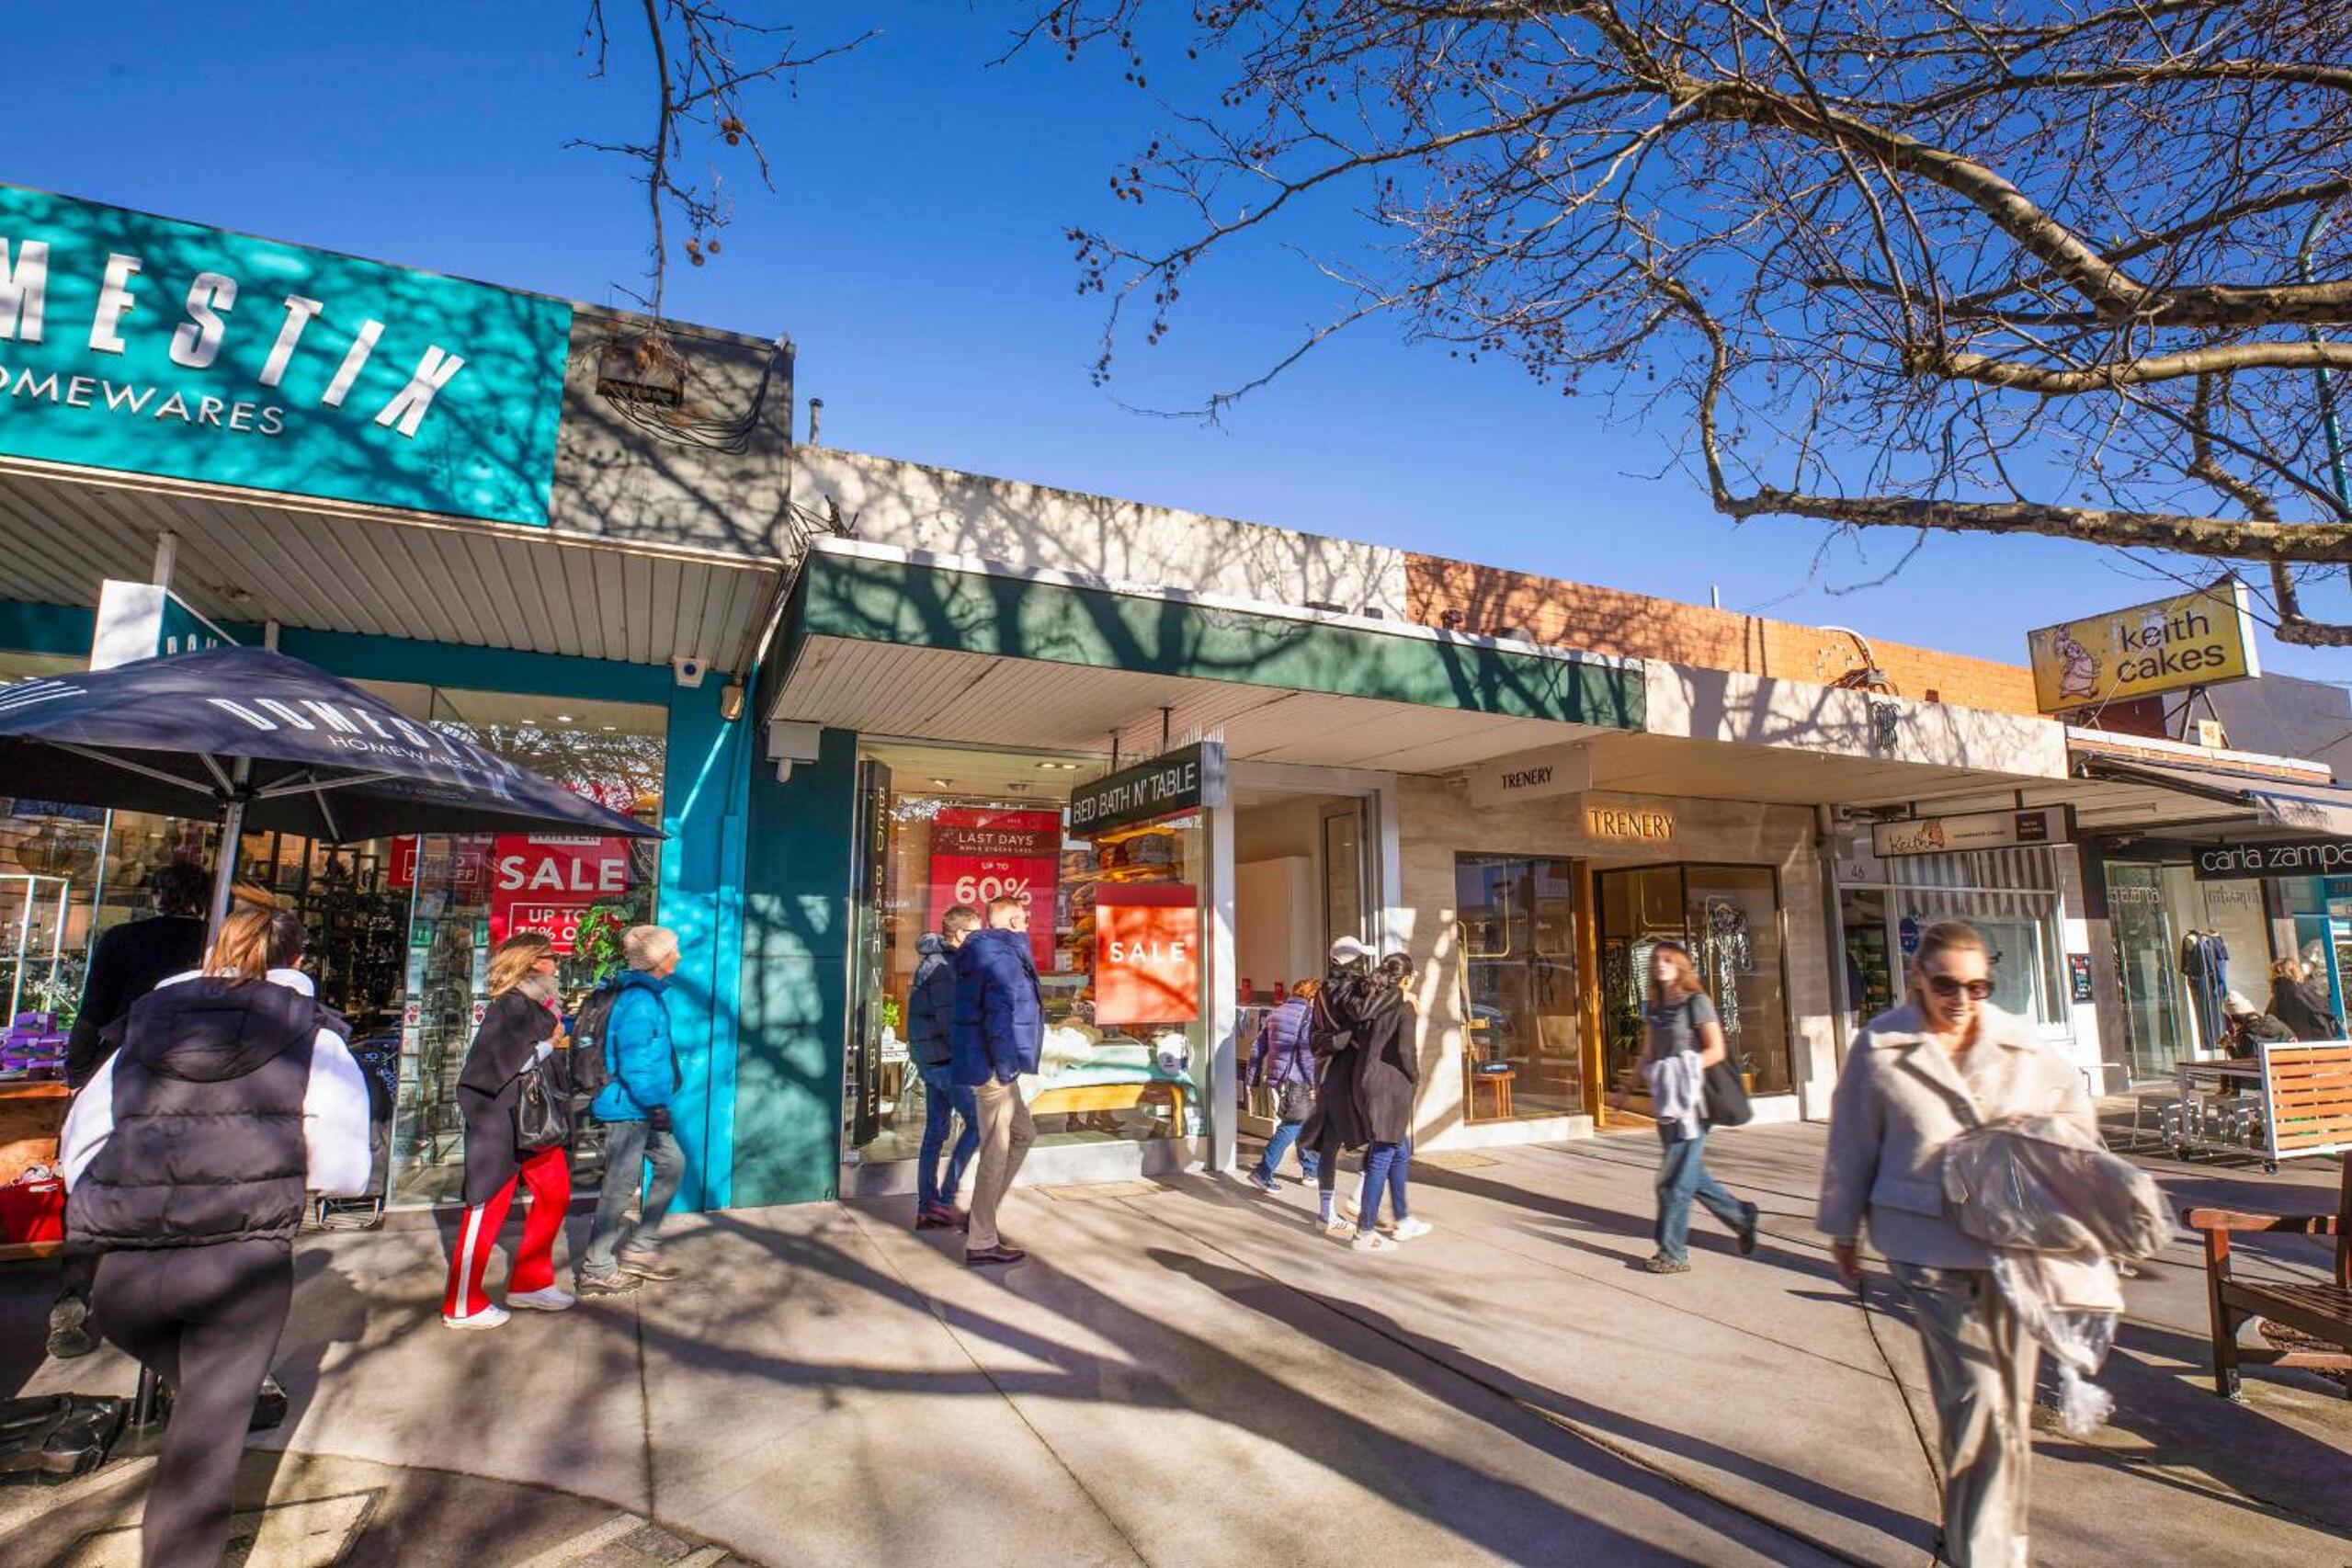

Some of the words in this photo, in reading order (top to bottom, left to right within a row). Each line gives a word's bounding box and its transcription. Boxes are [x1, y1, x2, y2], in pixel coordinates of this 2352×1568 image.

[2120, 610, 2210, 653] keith
[2118, 643, 2225, 683] cakes
[1501, 767, 1553, 790] TRENERY
[1074, 797, 1096, 824] BED
[1099, 784, 1130, 818] BATH
[1151, 763, 1196, 801] TABLE
[876, 786, 885, 851] BED
[1590, 810, 1675, 838] TRENERY
[959, 833, 994, 845] LAST
[998, 835, 1034, 846] DAYS
[996, 863, 1009, 871] TO
[1851, 865, 1866, 879] 46
[2202, 846, 2262, 871] carla
[499, 856, 625, 892] SALE
[955, 876, 1032, 905] 60%
[528, 909, 555, 923] UP
[872, 864, 883, 954] BATH
[1109, 942, 1186, 962] SALE
[868, 1002, 878, 1116] TABLE
